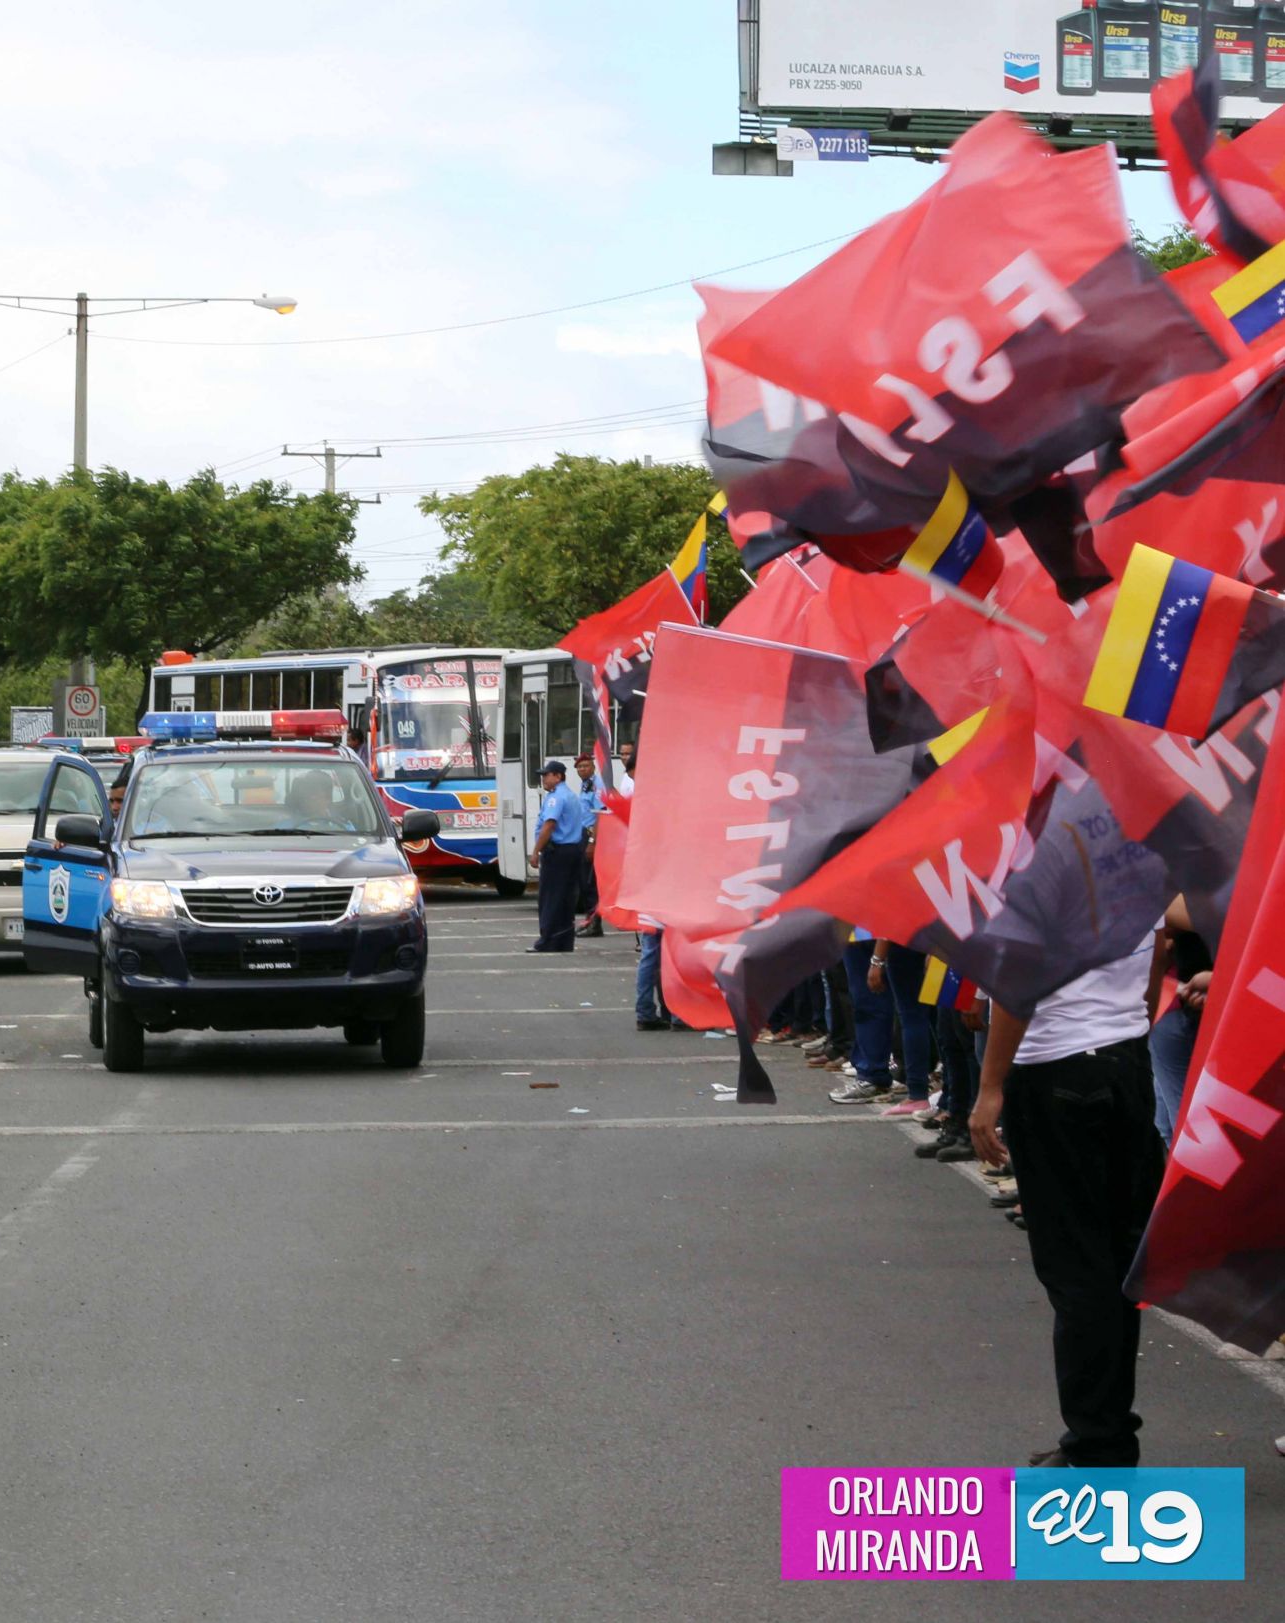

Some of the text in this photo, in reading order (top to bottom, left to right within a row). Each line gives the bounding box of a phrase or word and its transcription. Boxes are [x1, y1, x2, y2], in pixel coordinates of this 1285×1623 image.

[1161, 9, 1187, 25] Ursa
[1106, 25, 1130, 36] Ursa
[1215, 29, 1237, 40] Ursa
[1064, 34, 1083, 43] Ursa
[1004, 51, 1040, 61] Chevron
[789, 63, 925, 77] LUCALZA NICARAGUA S.A.
[789, 79, 862, 91] PBX 2255-9050
[819, 137, 842, 153] 2277
[844, 138, 868, 154] 1313
[74, 693, 90, 704] 60
[66, 719, 98, 729] VELOCIDAD
[397, 720, 415, 735] 048
